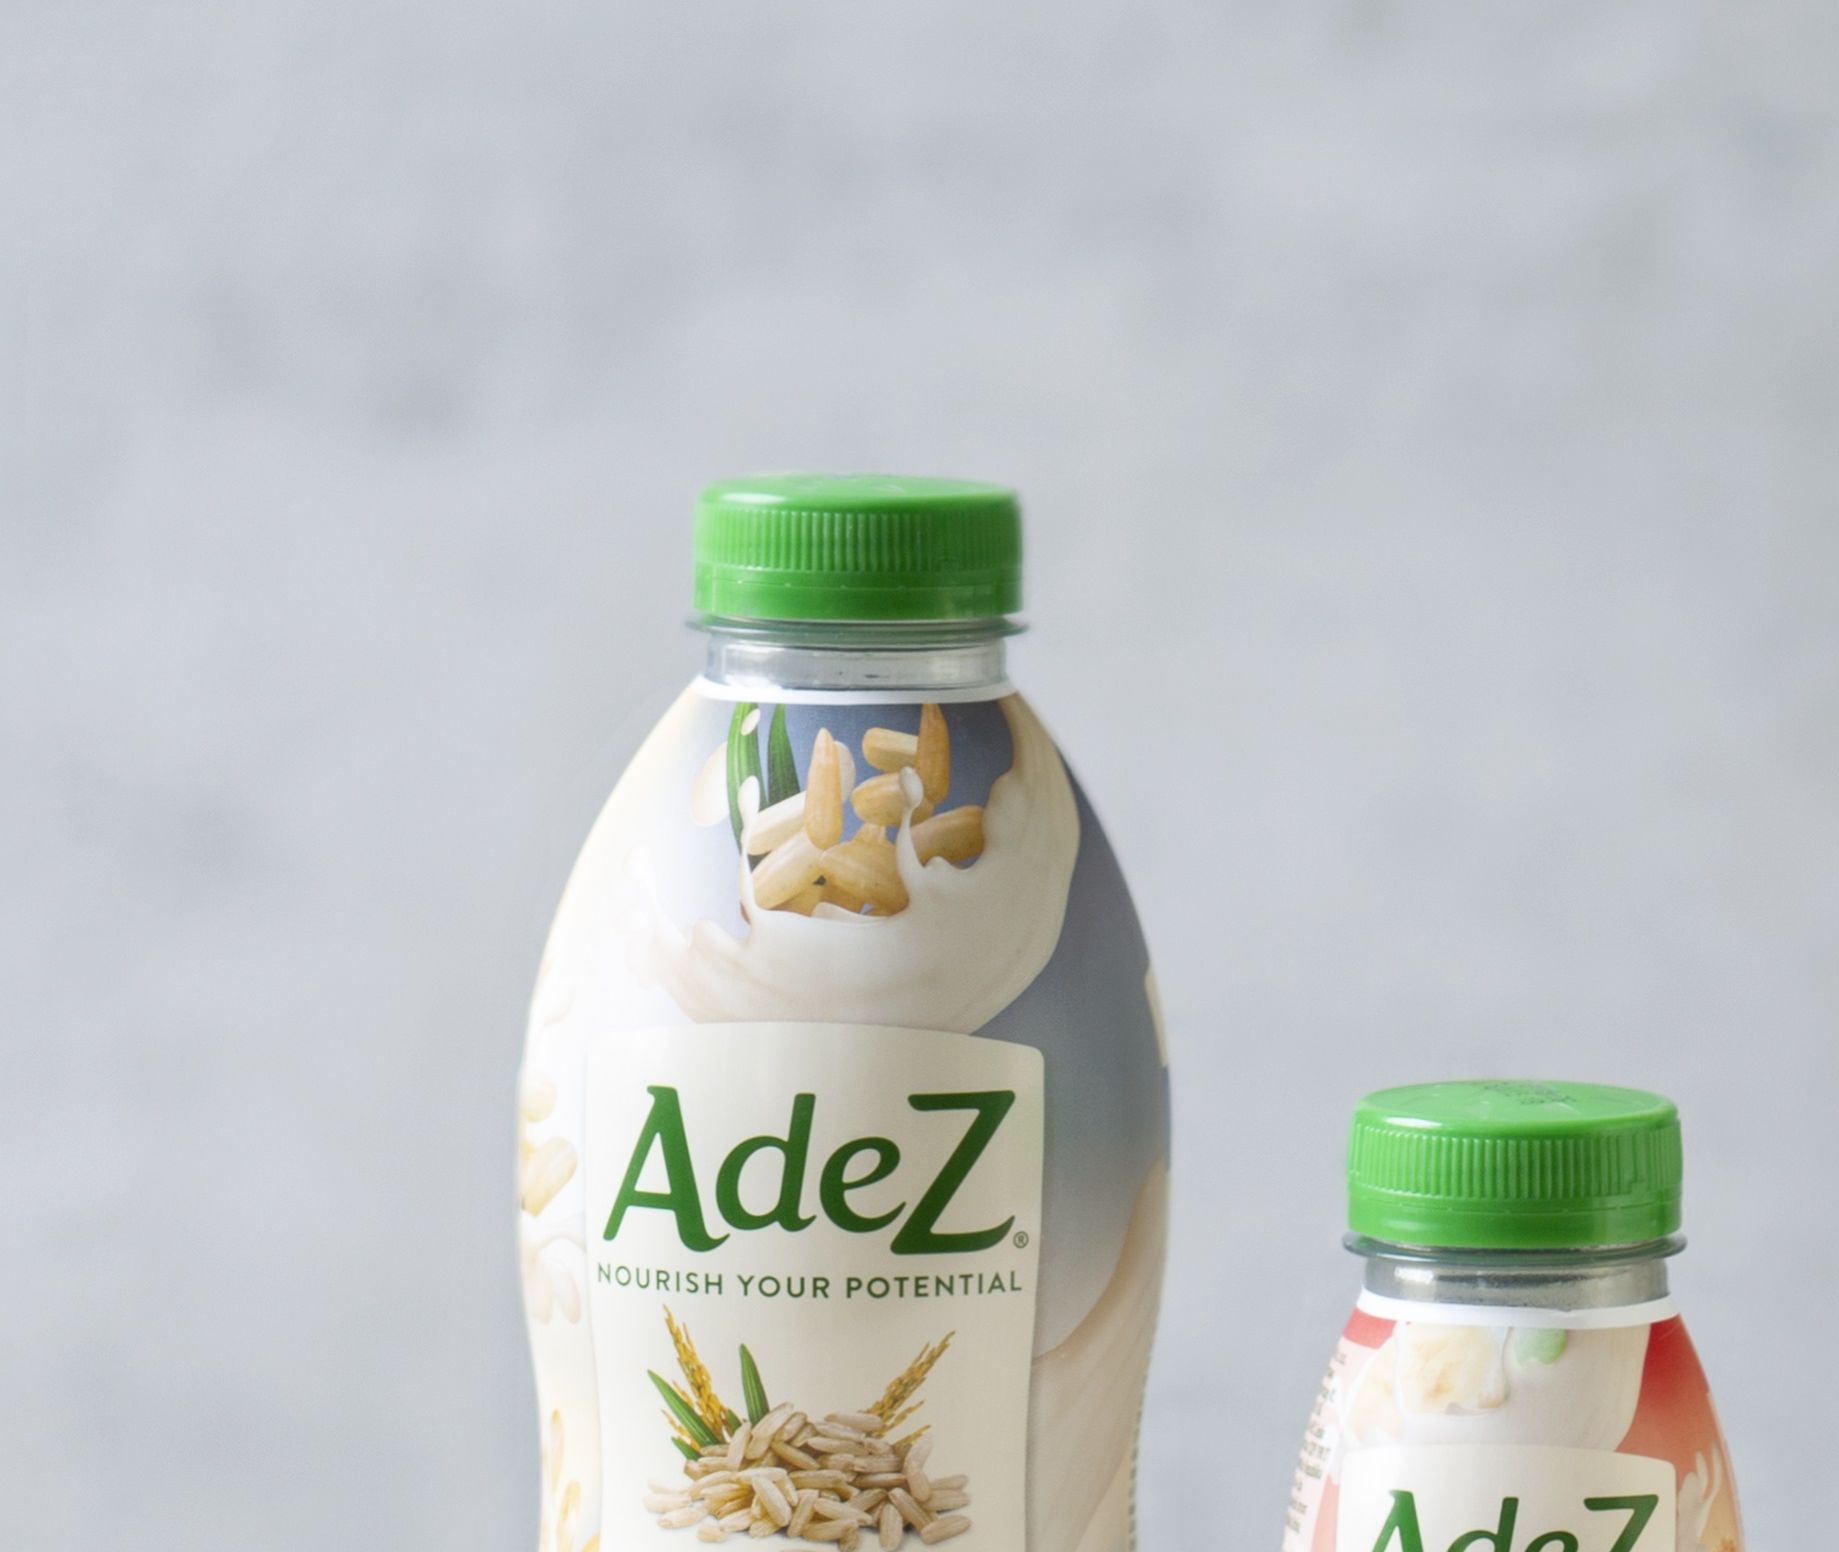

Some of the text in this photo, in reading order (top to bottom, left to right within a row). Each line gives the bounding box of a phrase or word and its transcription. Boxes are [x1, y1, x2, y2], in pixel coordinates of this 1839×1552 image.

[597, 1262, 1023, 1299] NOURISH YOUR POTENTIAL
